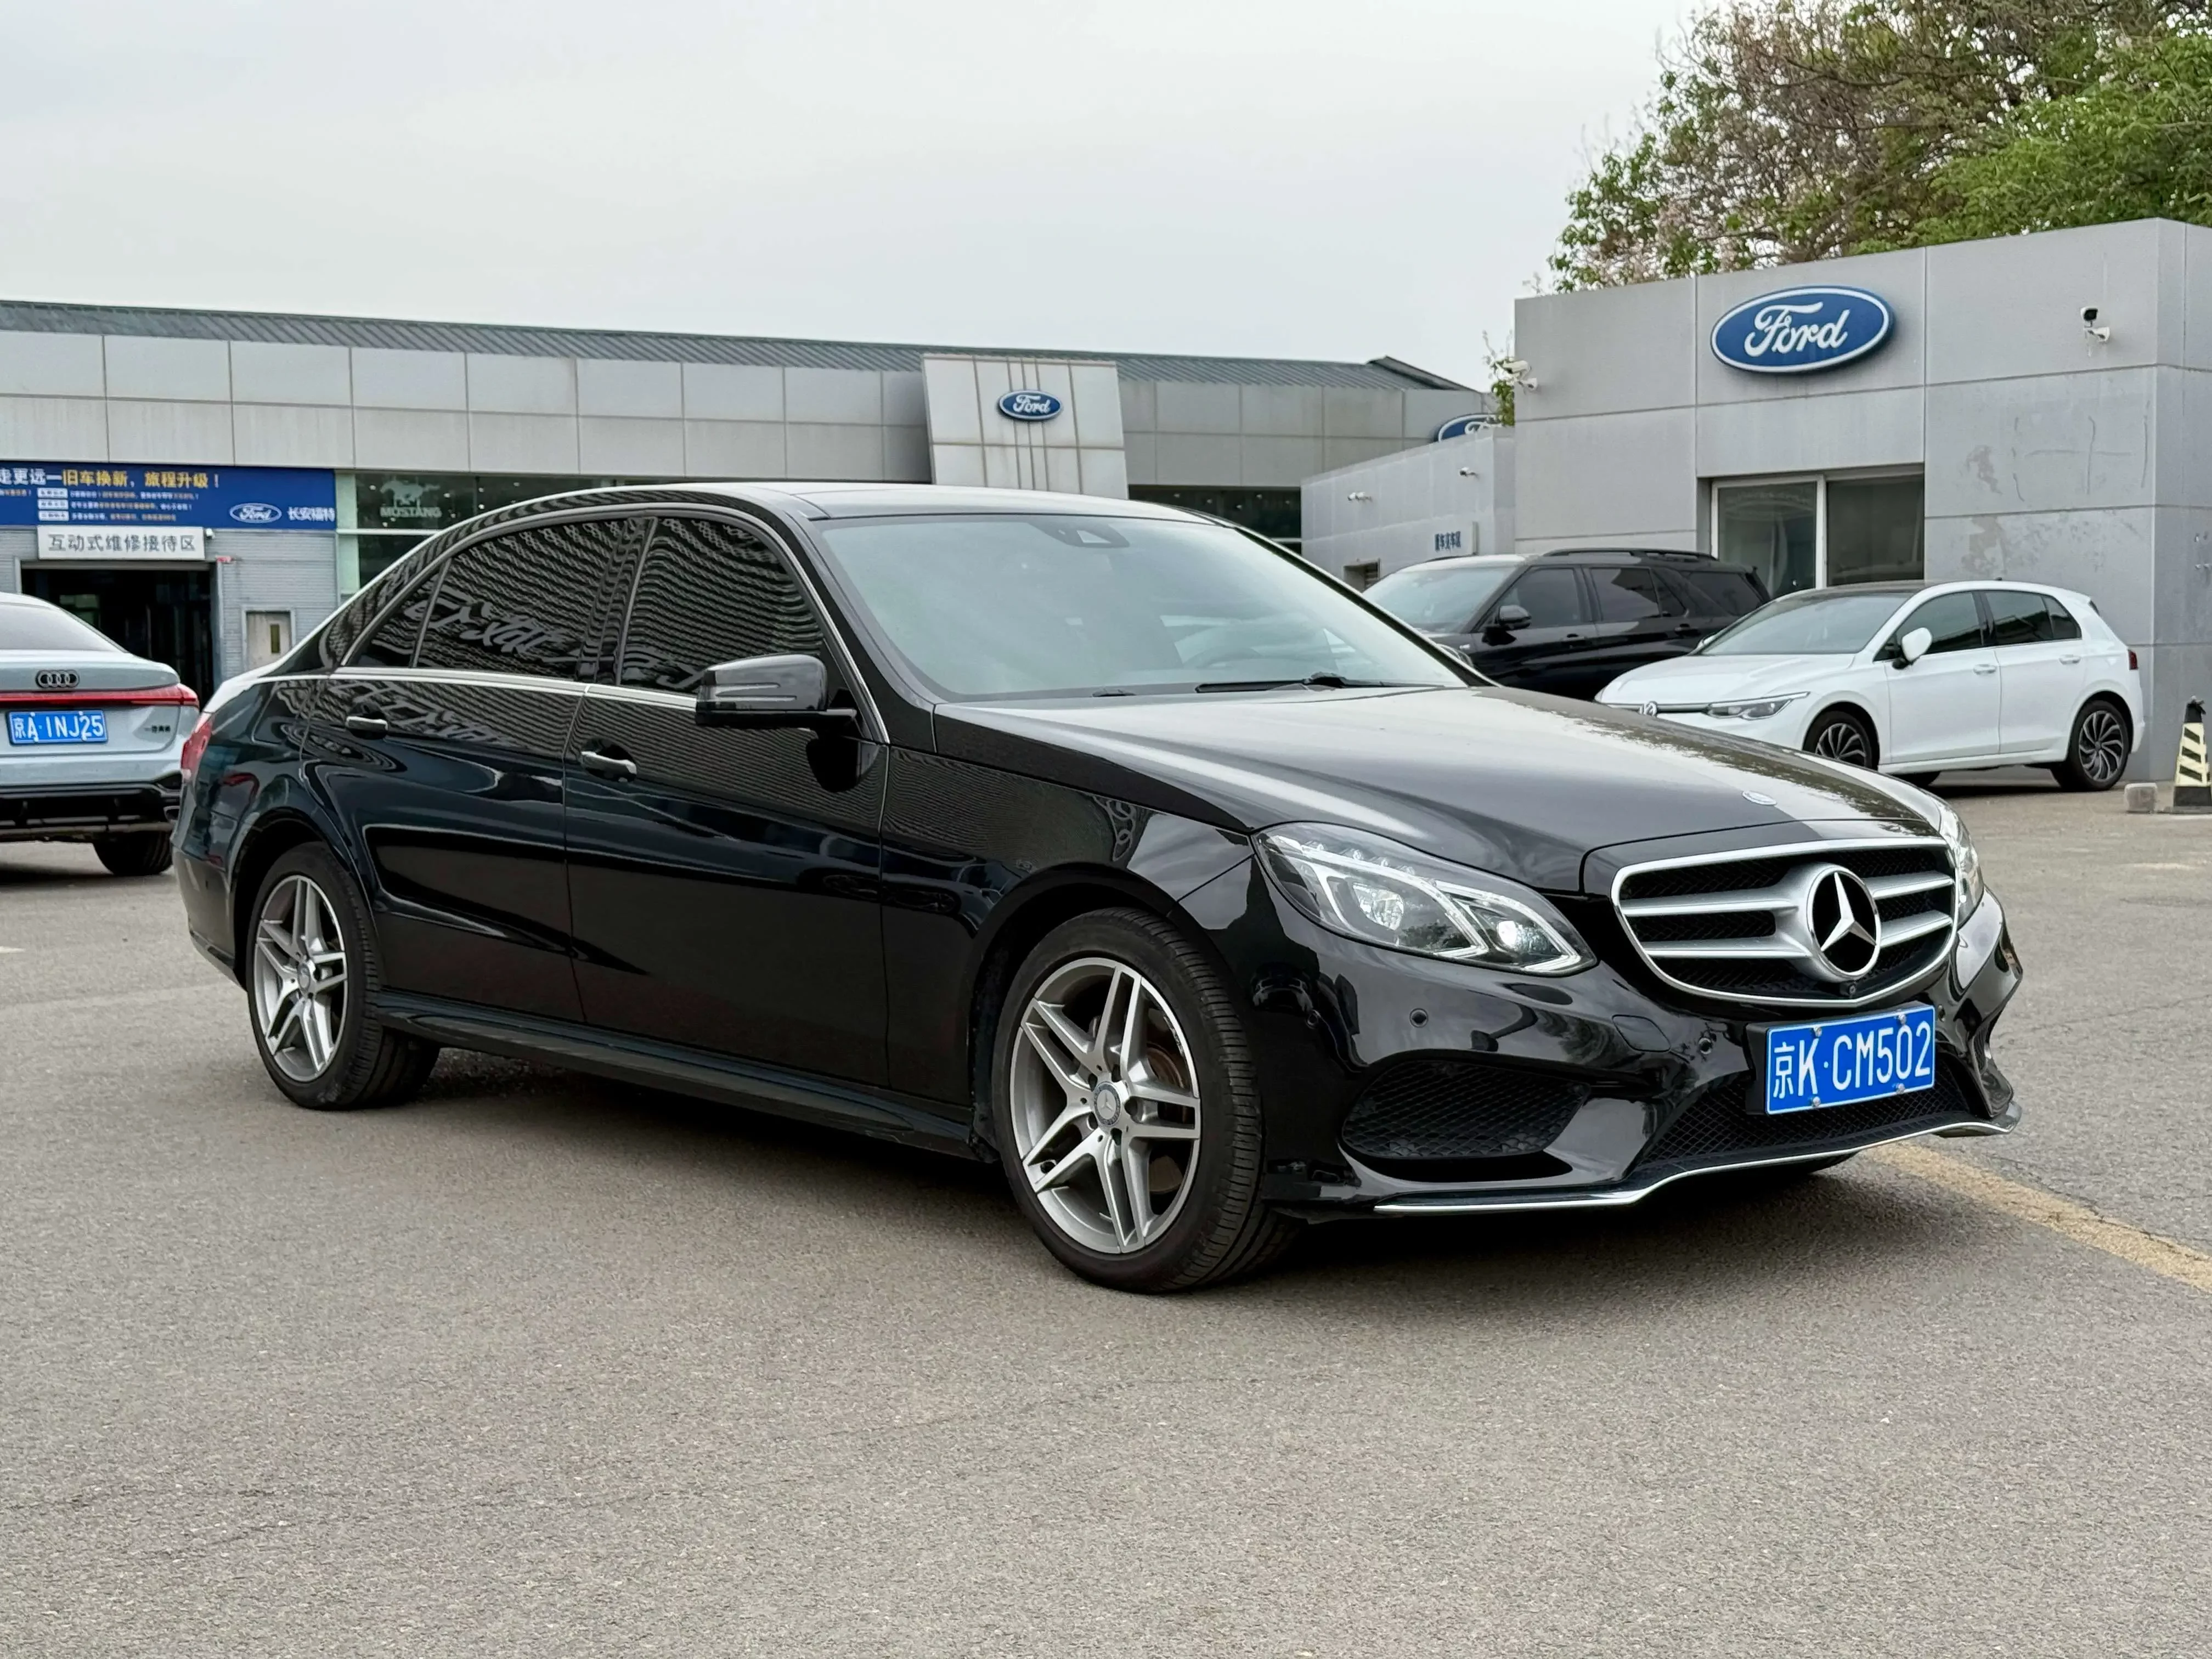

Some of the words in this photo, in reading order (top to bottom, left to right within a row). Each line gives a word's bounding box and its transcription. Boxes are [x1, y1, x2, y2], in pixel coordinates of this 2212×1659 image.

[1744, 301, 1850, 357] Ford
[1013, 394, 1051, 414] Ford
[239, 505, 272, 521] Ford
[380, 507, 442, 517] MUSTANG
[48, 534, 196, 553] 互动式维修接待区
[1773, 1020, 1931, 1099] 京K·CM502
